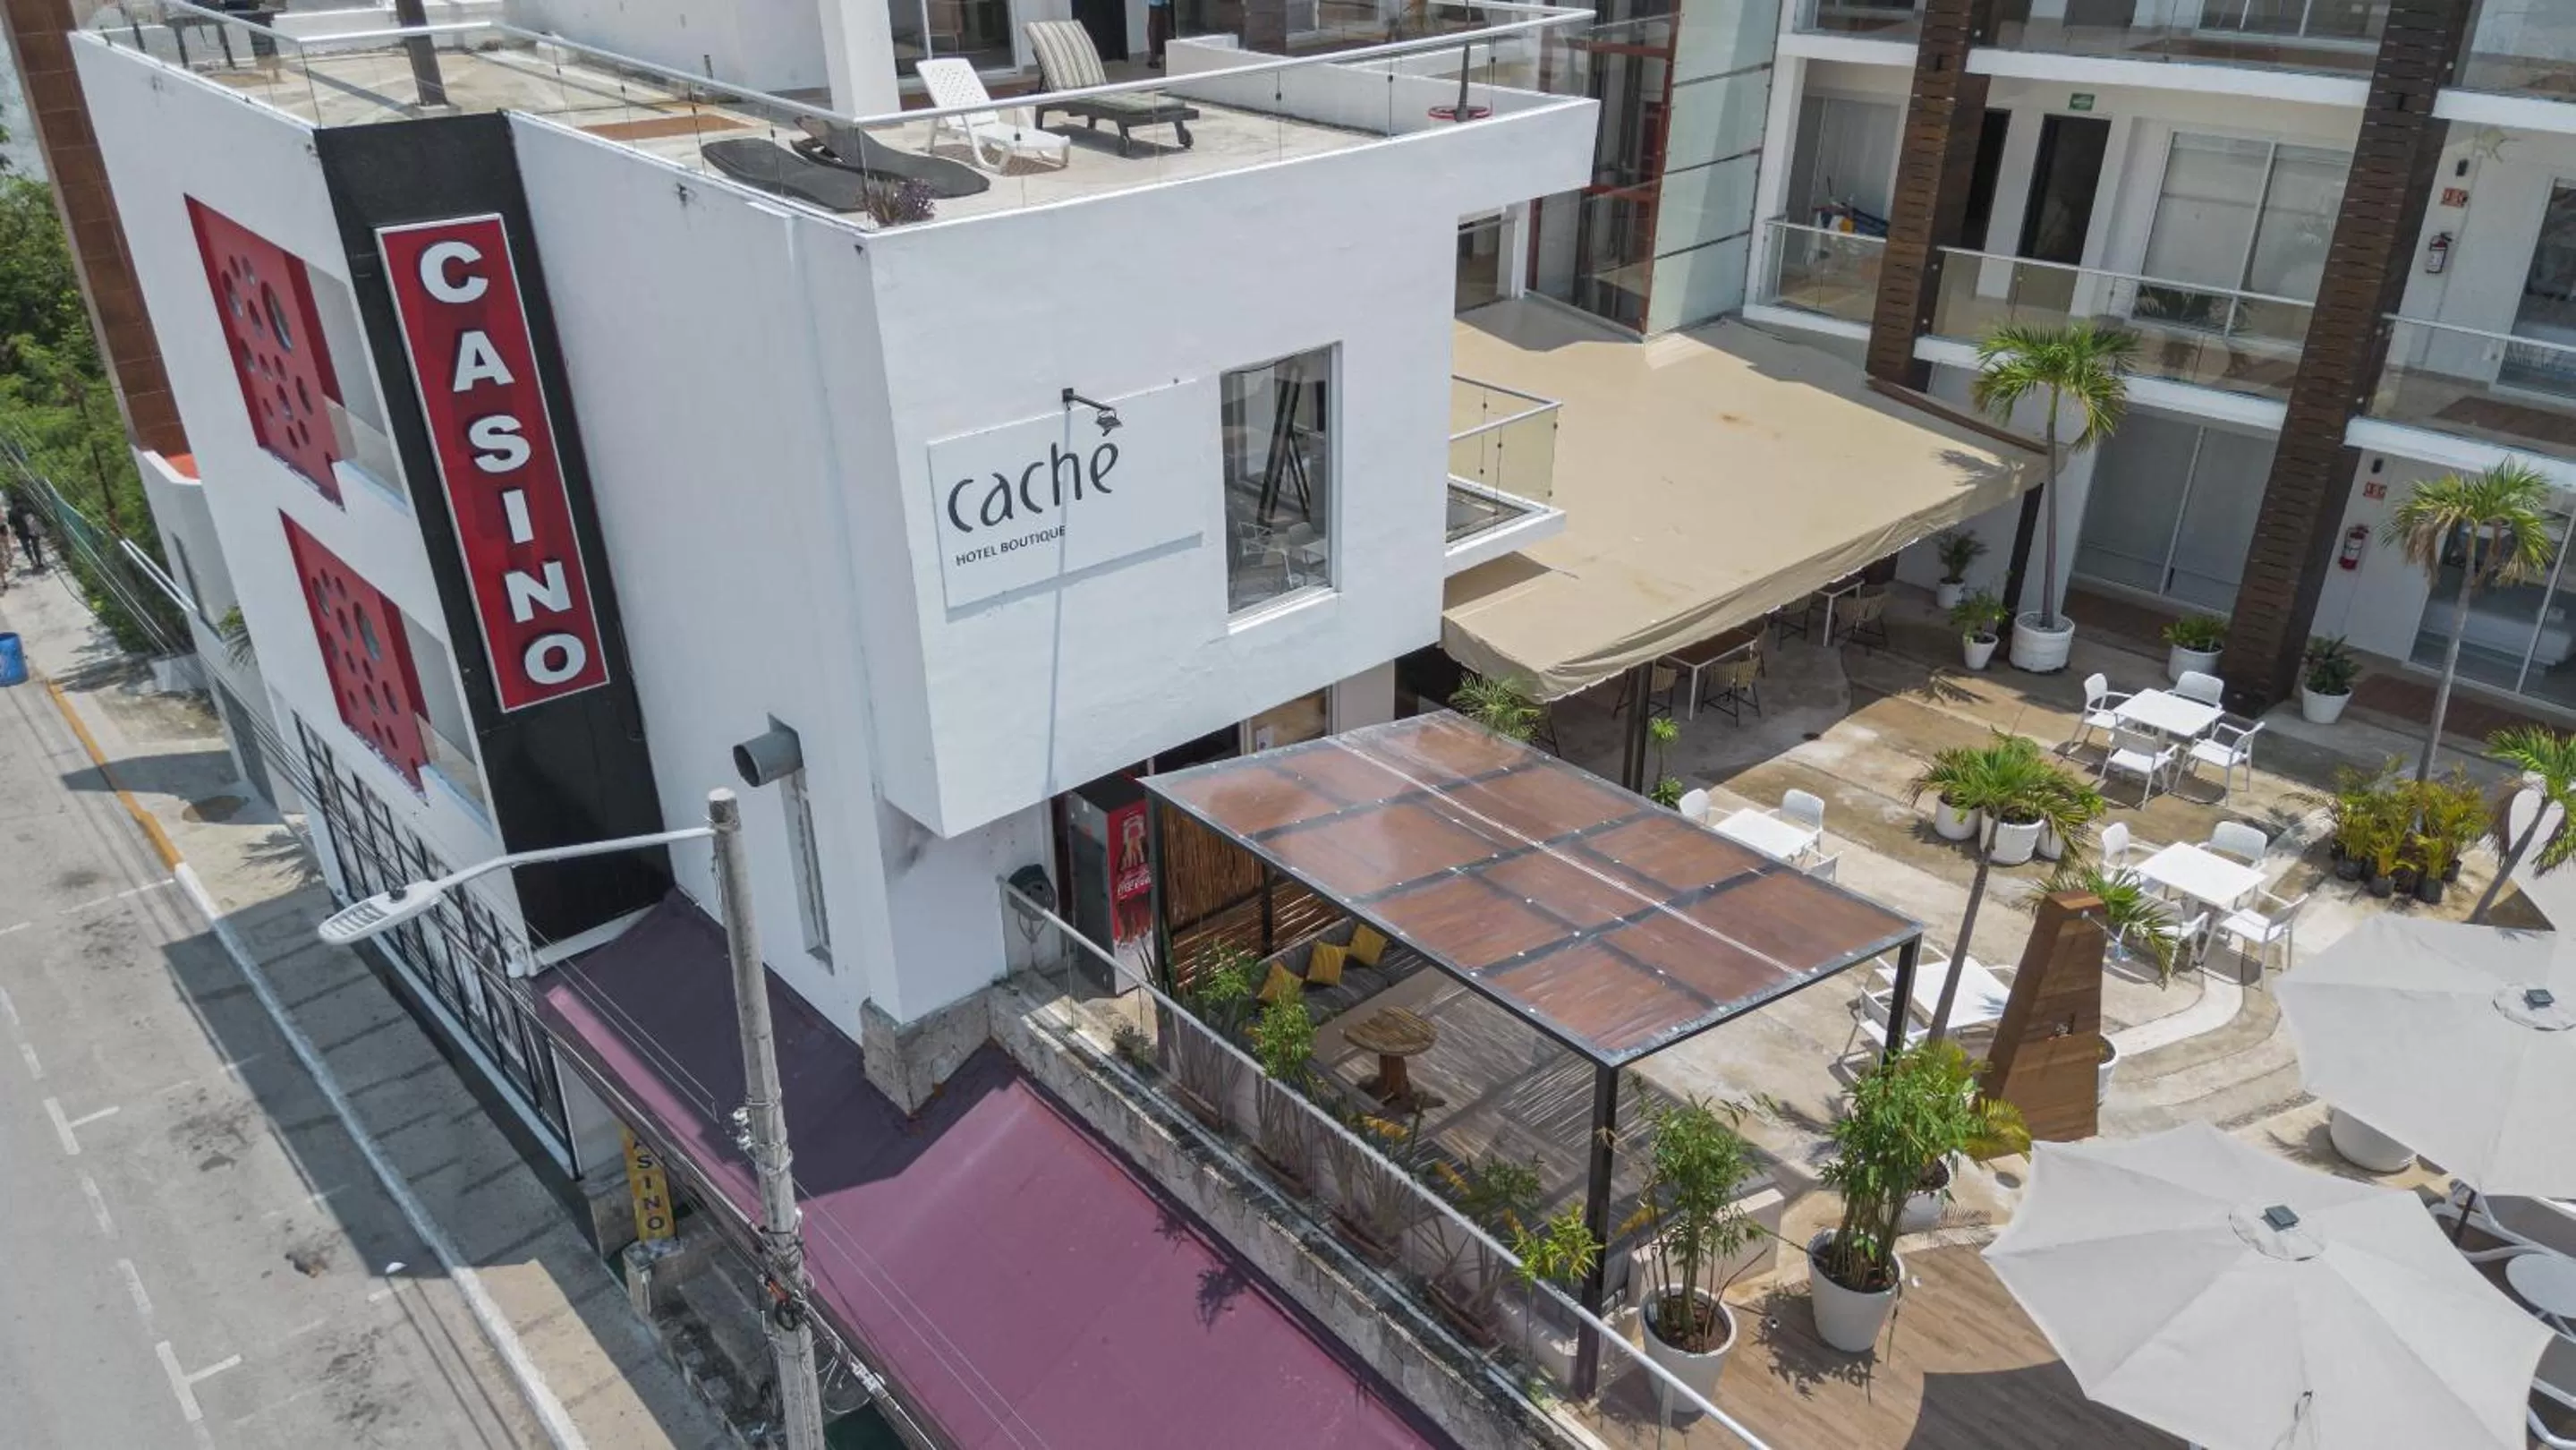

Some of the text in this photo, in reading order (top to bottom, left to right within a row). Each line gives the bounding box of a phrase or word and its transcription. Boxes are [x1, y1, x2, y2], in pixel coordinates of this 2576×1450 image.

[419, 240, 587, 685] CASINO
[948, 428, 1118, 533] caché
[956, 525, 1066, 566] HOTEL BOUTIQUE
[634, 1139, 665, 1230] SINO
